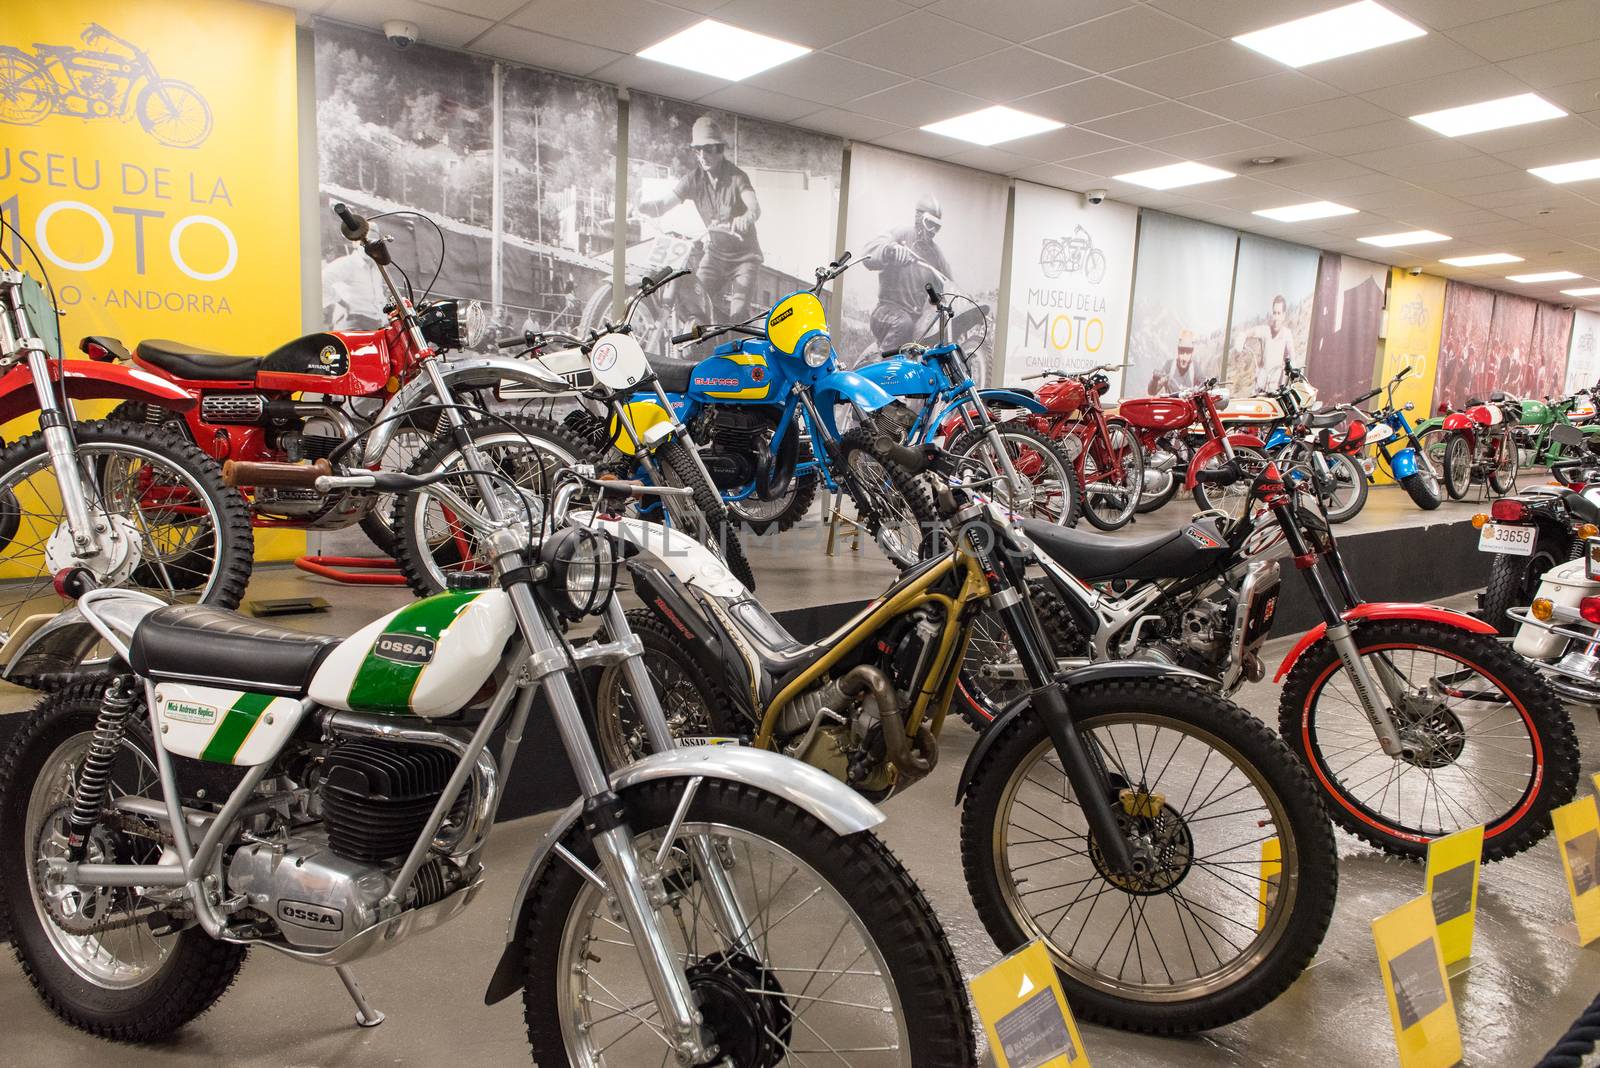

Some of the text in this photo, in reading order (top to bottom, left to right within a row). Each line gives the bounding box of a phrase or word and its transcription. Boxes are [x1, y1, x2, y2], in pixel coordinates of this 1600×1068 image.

[121, 162, 172, 200] DE
[189, 172, 233, 207] LA
[104, 288, 232, 315] ANDORRA
[1027, 287, 1106, 312] MUSEU DE LA
[1025, 311, 1104, 353] MOTO
[1025, 355, 1060, 369] CANILLO
[1495, 529, 1531, 544] 33659
[380, 640, 427, 657] OSSA
[1342, 652, 1383, 727] www.multimoto.ad
[167, 702, 178, 712] Mick
[179, 704, 197, 715] Andrews
[198, 706, 214, 718] Replica
[283, 906, 335, 925] OSSA
